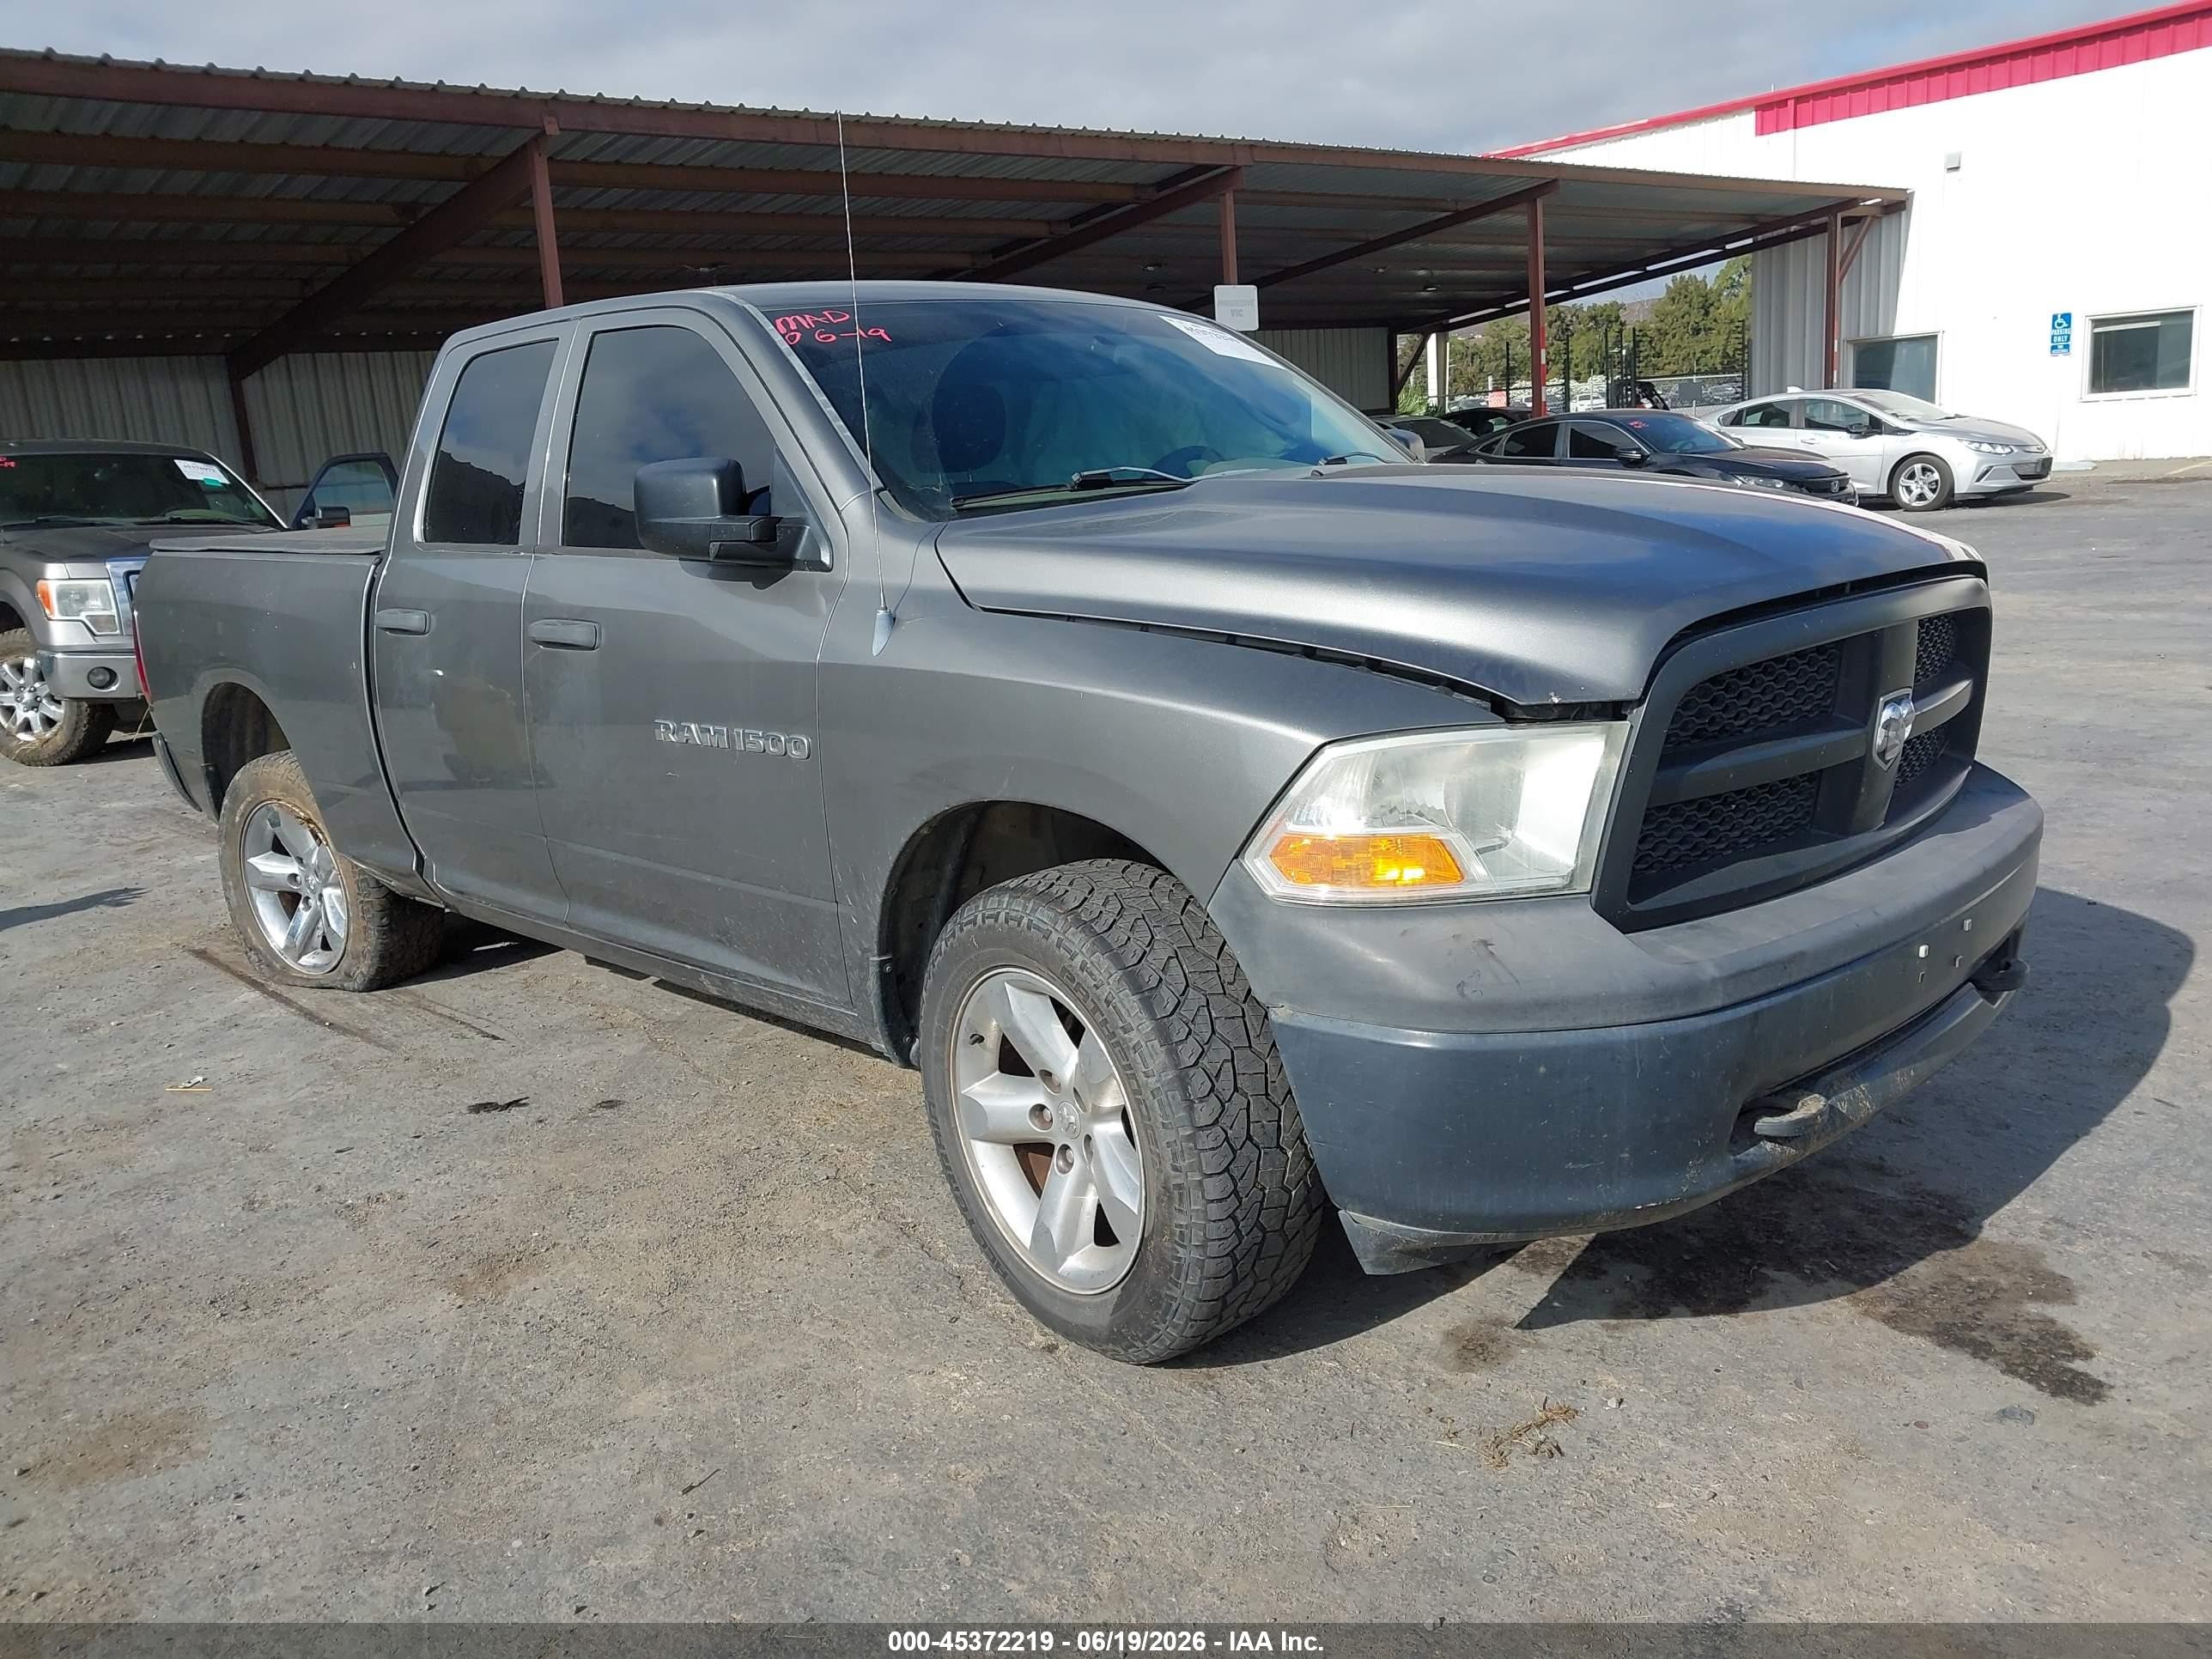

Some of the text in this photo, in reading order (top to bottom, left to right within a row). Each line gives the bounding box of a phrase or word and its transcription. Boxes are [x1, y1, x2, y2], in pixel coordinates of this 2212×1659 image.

[775, 310, 850, 335] MAD
[653, 719, 811, 760] RAM 1500
